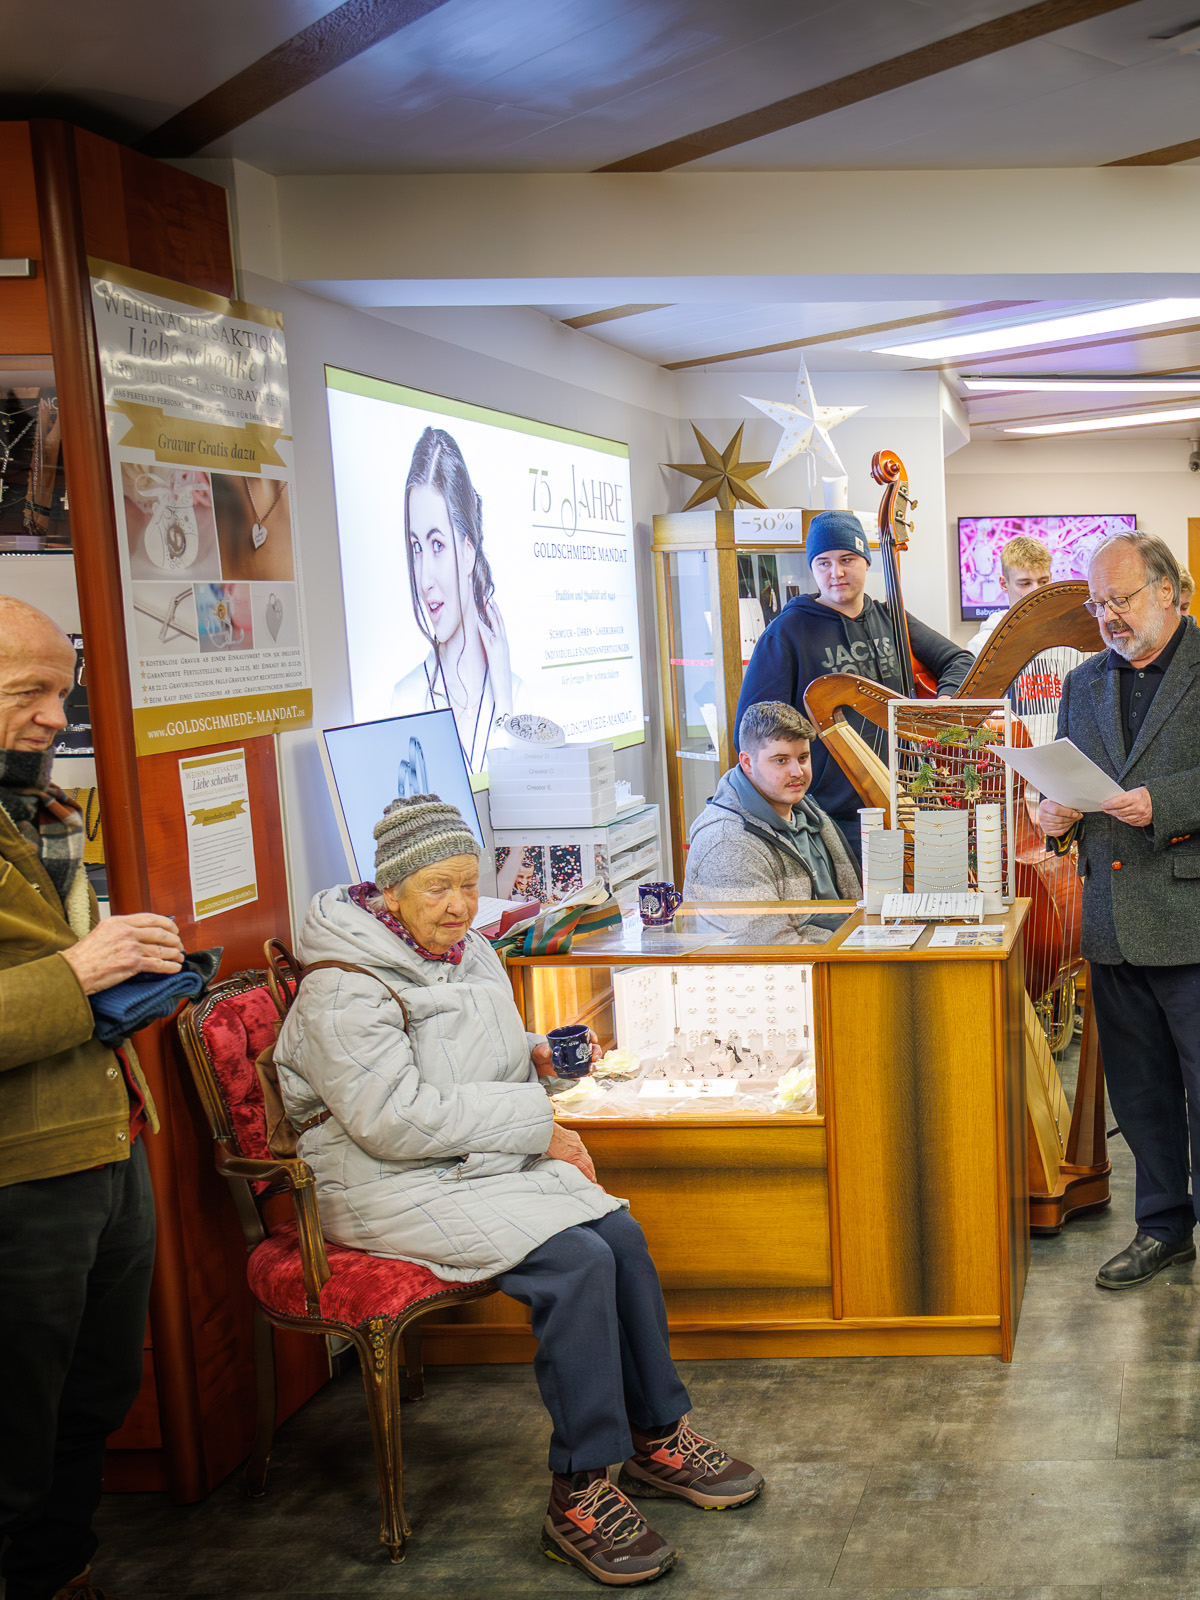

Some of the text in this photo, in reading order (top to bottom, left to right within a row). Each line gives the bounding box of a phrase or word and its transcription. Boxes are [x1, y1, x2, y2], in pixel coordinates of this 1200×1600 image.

[103, 289, 280, 354] WEIHNACHTSAKTION
[128, 326, 179, 366] Liebe
[157, 433, 256, 461] Gravur Gratis dazu
[528, 464, 626, 538] 75 JAHRE
[533, 541, 628, 563] GOLDSCHMIEDE MANDAT
[1018, 686, 1062, 701] JONES
